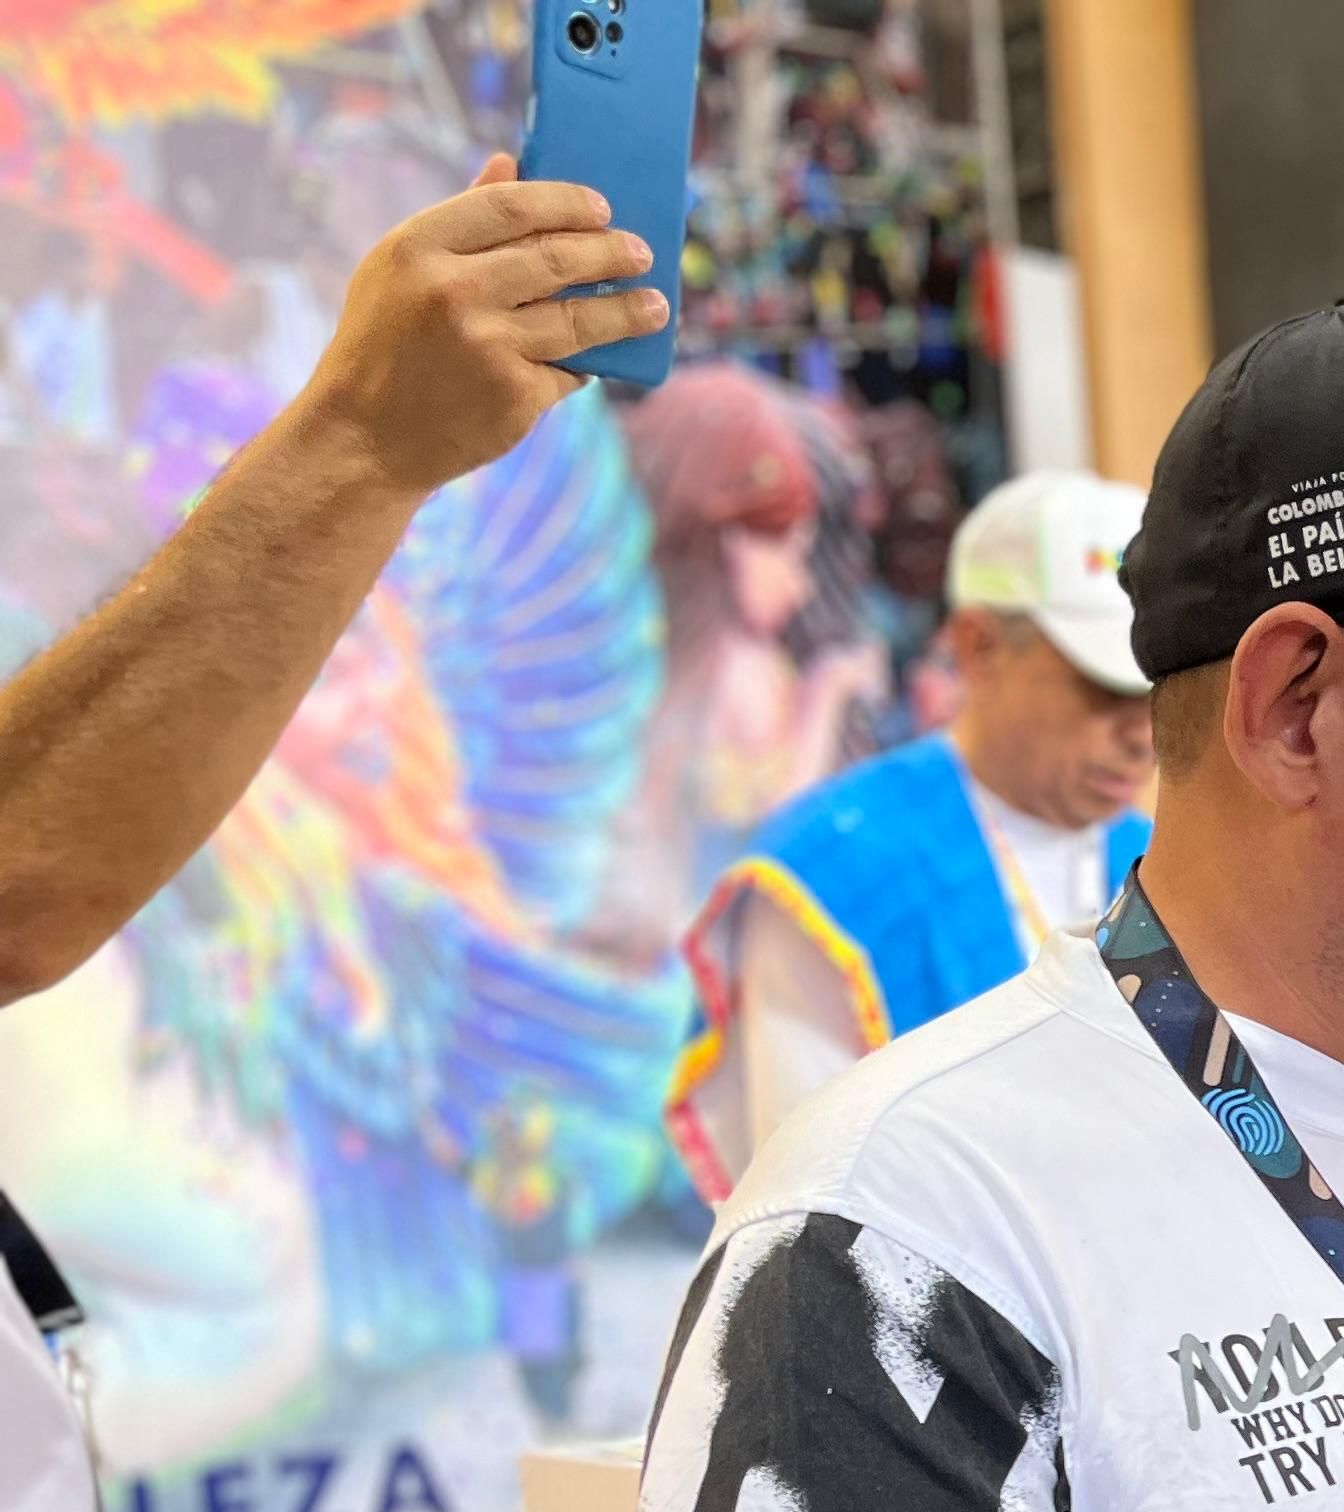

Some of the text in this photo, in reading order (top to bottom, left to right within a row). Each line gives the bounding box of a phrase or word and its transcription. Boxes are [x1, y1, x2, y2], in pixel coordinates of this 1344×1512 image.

[1291, 476, 1327, 493] VIAJA
[1268, 532, 1295, 559] EL
[1267, 561, 1300, 589] LA
[1231, 1402, 1312, 1449] WHY
[1239, 1437, 1336, 1504] TRY
